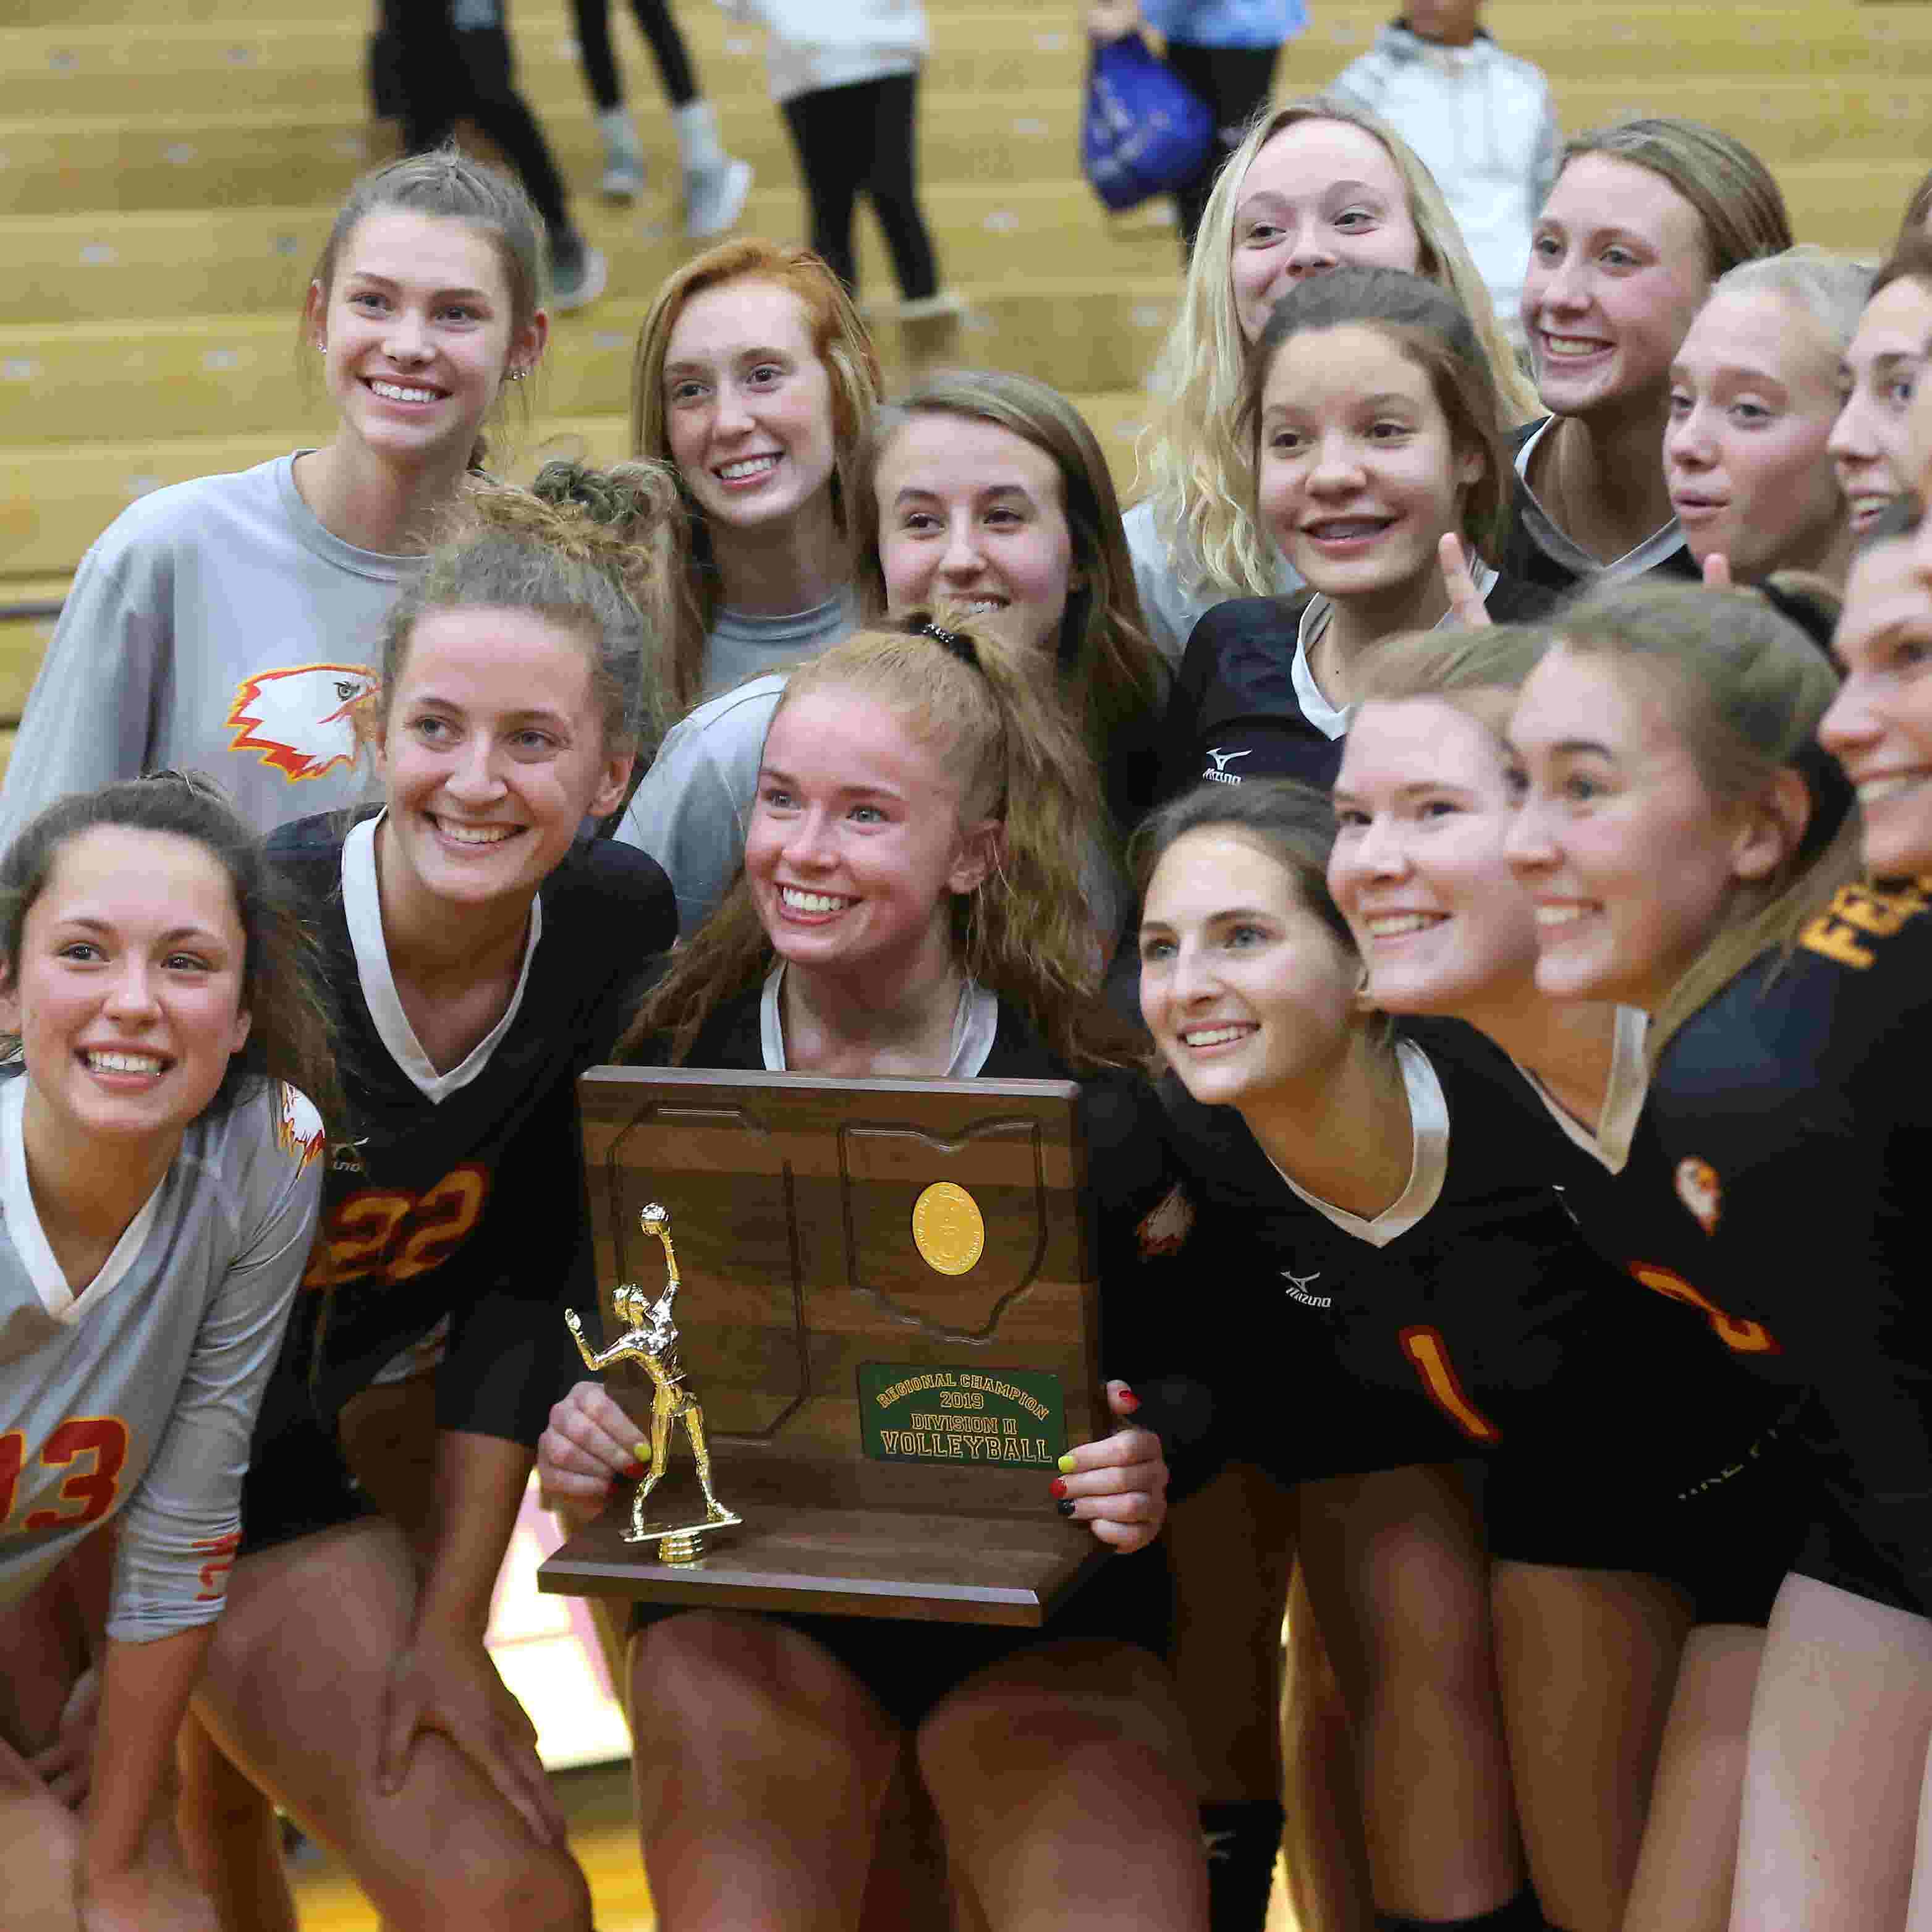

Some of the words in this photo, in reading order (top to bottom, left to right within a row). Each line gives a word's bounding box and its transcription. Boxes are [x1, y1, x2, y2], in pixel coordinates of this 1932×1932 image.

[301, 1163, 491, 1293] 22
[876, 1373, 957, 1409] REGIONAL
[959, 1374, 1050, 1421] CHAMPION
[939, 1391, 985, 1410] 2019
[1396, 1325, 1502, 1444] 1
[880, 1430, 1054, 1464] VOLLEYBALL
[911, 1413, 999, 1434] DIVISION
[1002, 1418, 1018, 1435] II
[0, 1415, 130, 1534] 13
